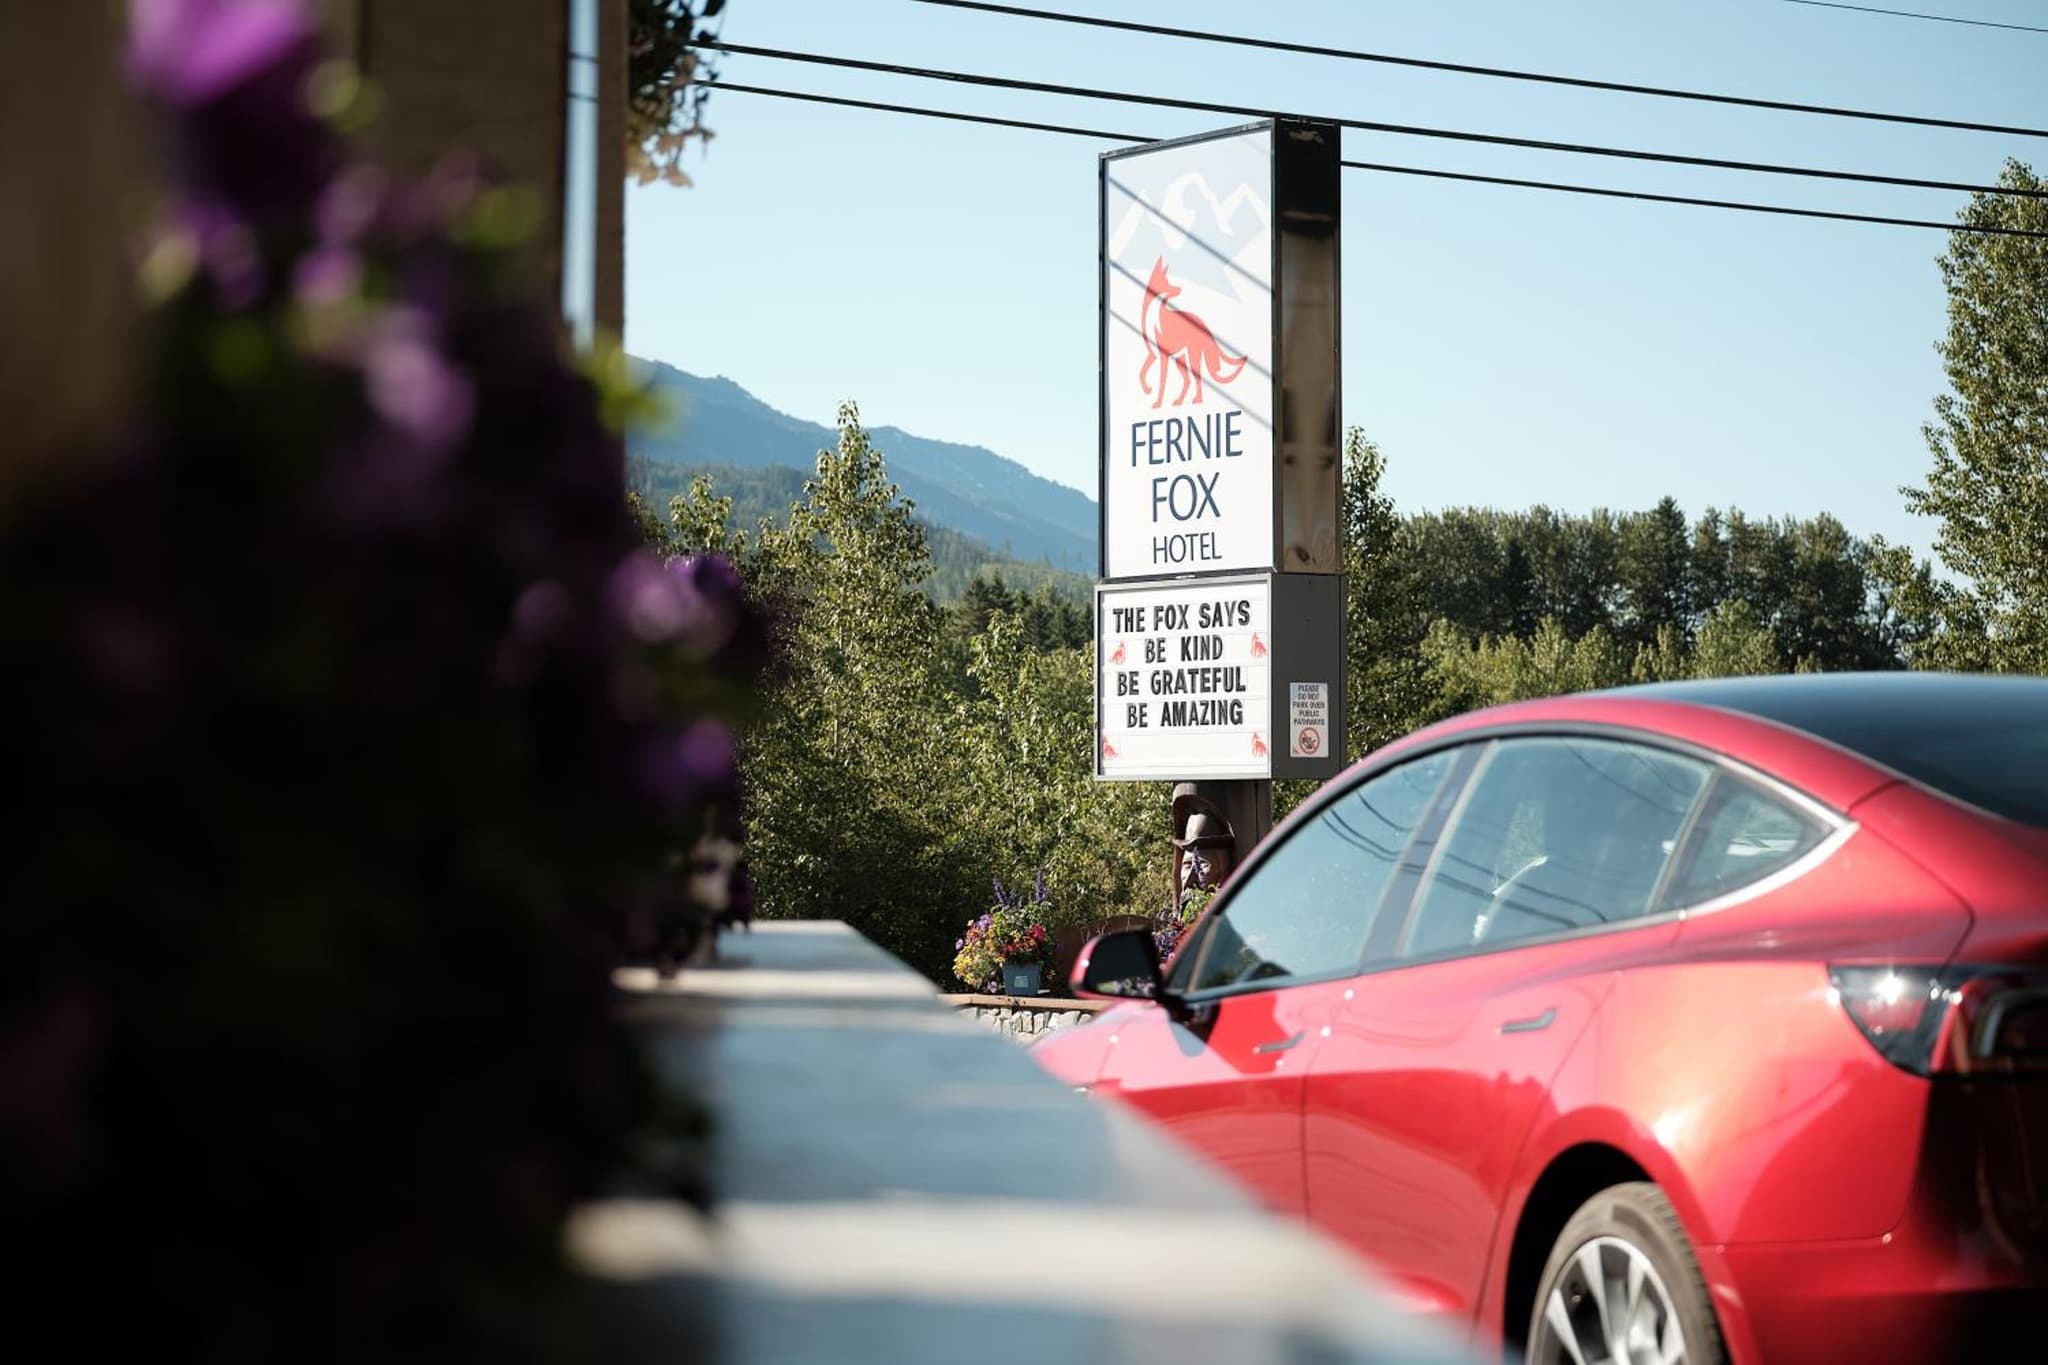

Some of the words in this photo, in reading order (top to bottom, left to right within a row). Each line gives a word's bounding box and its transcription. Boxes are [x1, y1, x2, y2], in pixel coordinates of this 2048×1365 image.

[1131, 410, 1243, 467] FERNIE
[1152, 472, 1221, 522] FOX
[1153, 531, 1222, 564] HOTEL
[1113, 607, 1145, 634] THE
[1153, 604, 1189, 631] FOX
[1198, 600, 1250, 629] SAYS
[1145, 637, 1167, 664] BE
[1180, 634, 1223, 662] KIND
[1117, 671, 1139, 696] BE
[1151, 666, 1246, 696] GRATEFUL
[1298, 684, 1319, 692] PLEASE
[1127, 702, 1148, 728] BE
[1160, 699, 1243, 727] AMAZING
